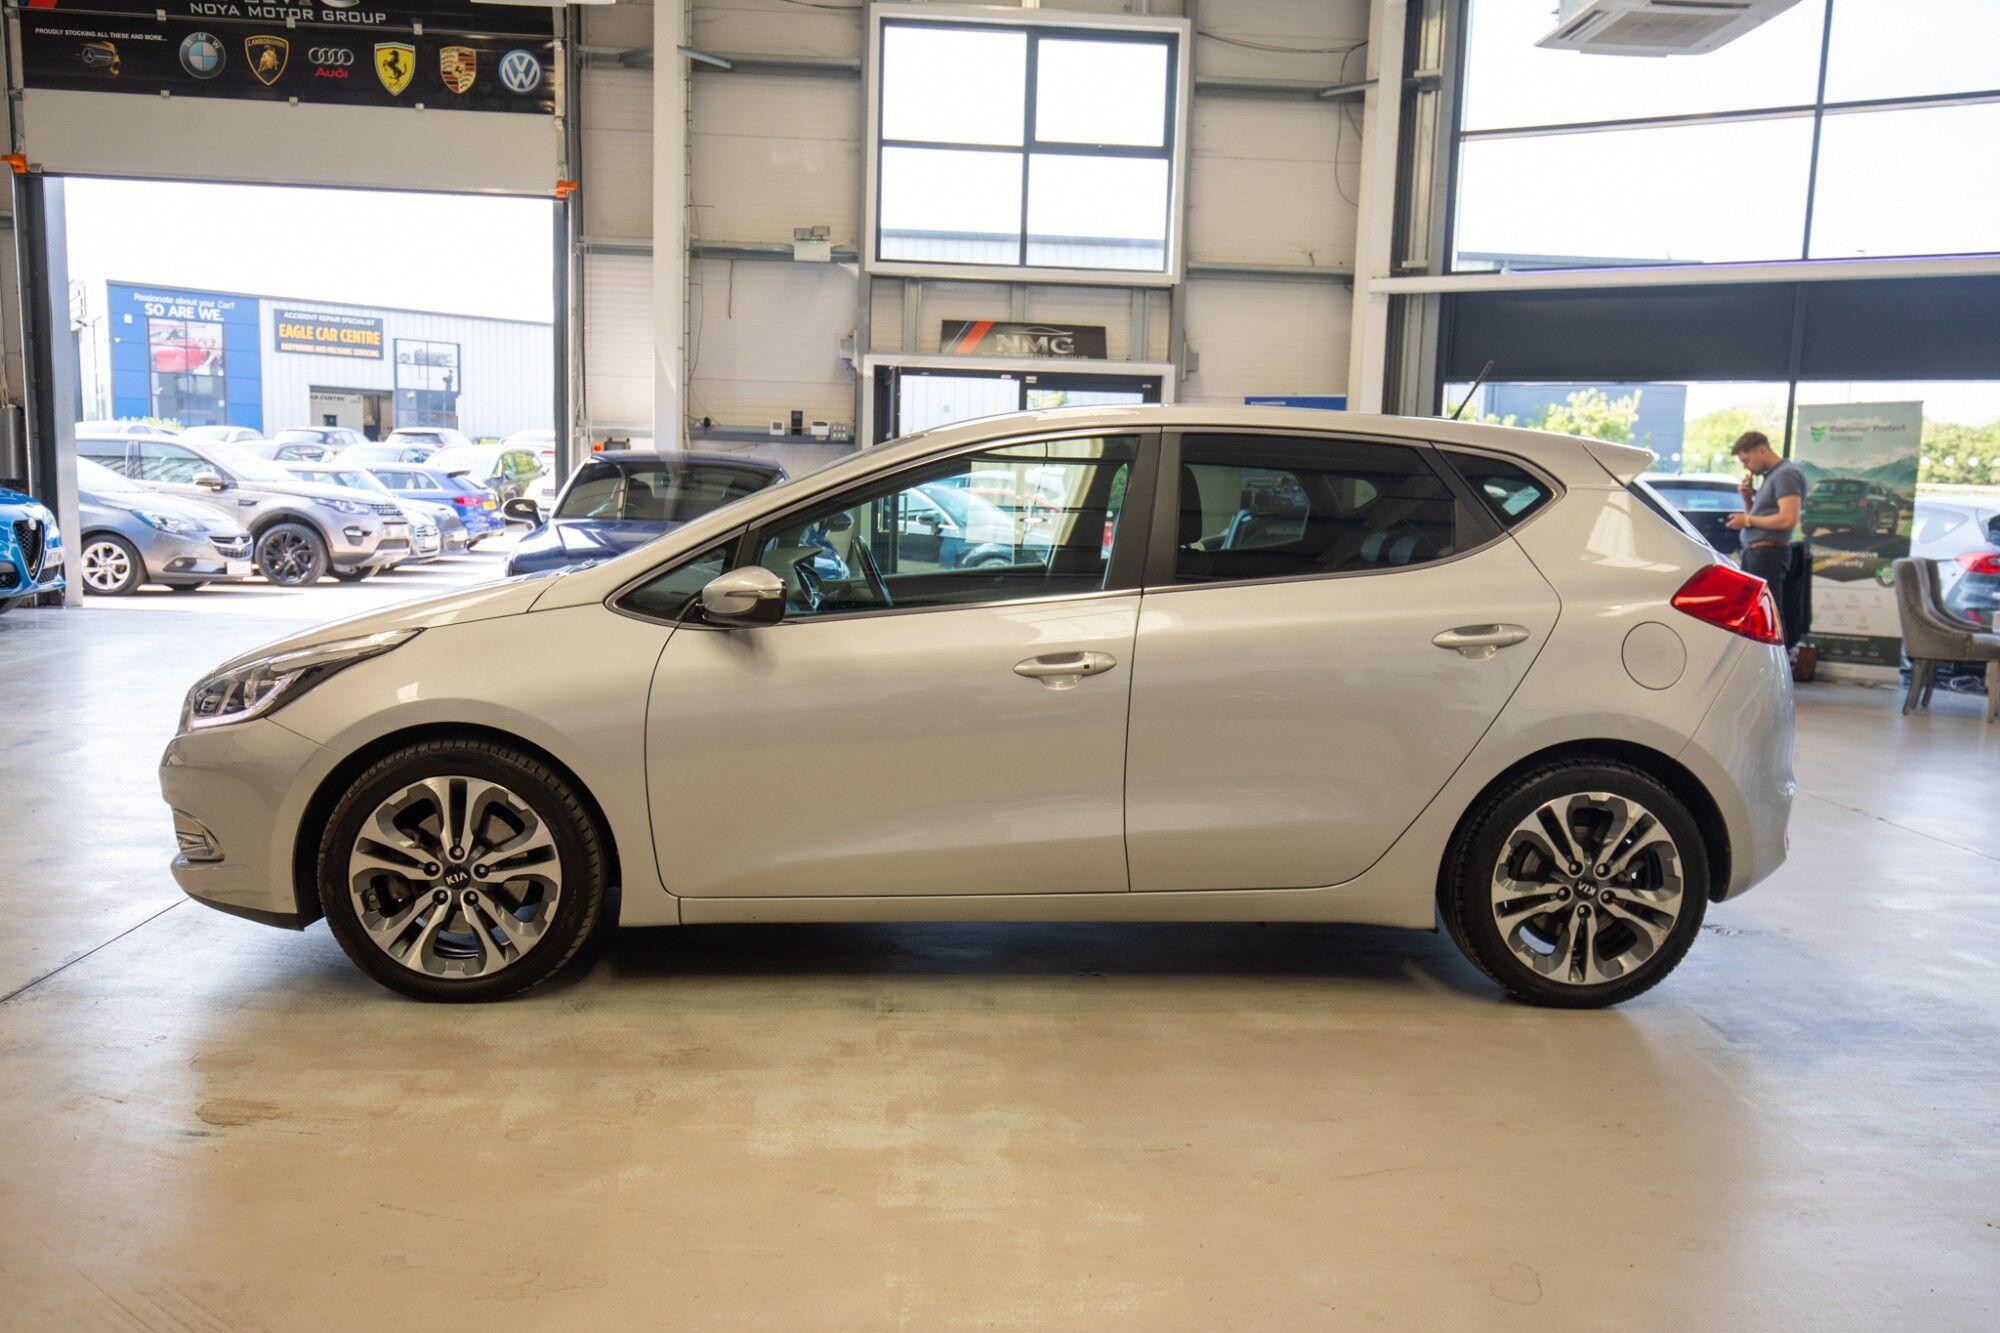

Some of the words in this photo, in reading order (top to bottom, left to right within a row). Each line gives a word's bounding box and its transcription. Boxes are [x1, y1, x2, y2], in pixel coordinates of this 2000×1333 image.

[190, 3, 240, 16] NOYA
[248, 6, 314, 20] MOTOR
[322, 10, 387, 24] GROUP
[35, 28, 64, 36] PROUDLY
[65, 30, 96, 38] STOCKING
[184, 34, 221, 49] BMW
[315, 67, 349, 78] Audi
[134, 292, 174, 304] Passionate
[175, 297, 198, 307] about
[198, 299, 216, 309] your
[144, 303, 165, 316] SO
[168, 305, 196, 319] ARE
[198, 307, 225, 321] WE.
[283, 311, 318, 321] ACCIDENT
[319, 314, 341, 323] REPAIR
[341, 316, 375, 326] SPECIALIST
[279, 323, 314, 340] EAGLE
[315, 326, 338, 342] CAR
[339, 328, 380, 346] CENTRE
[995, 333, 1075, 355] NMG
[445, 871, 468, 885] KIA
[1578, 881, 1597, 896] KIA
